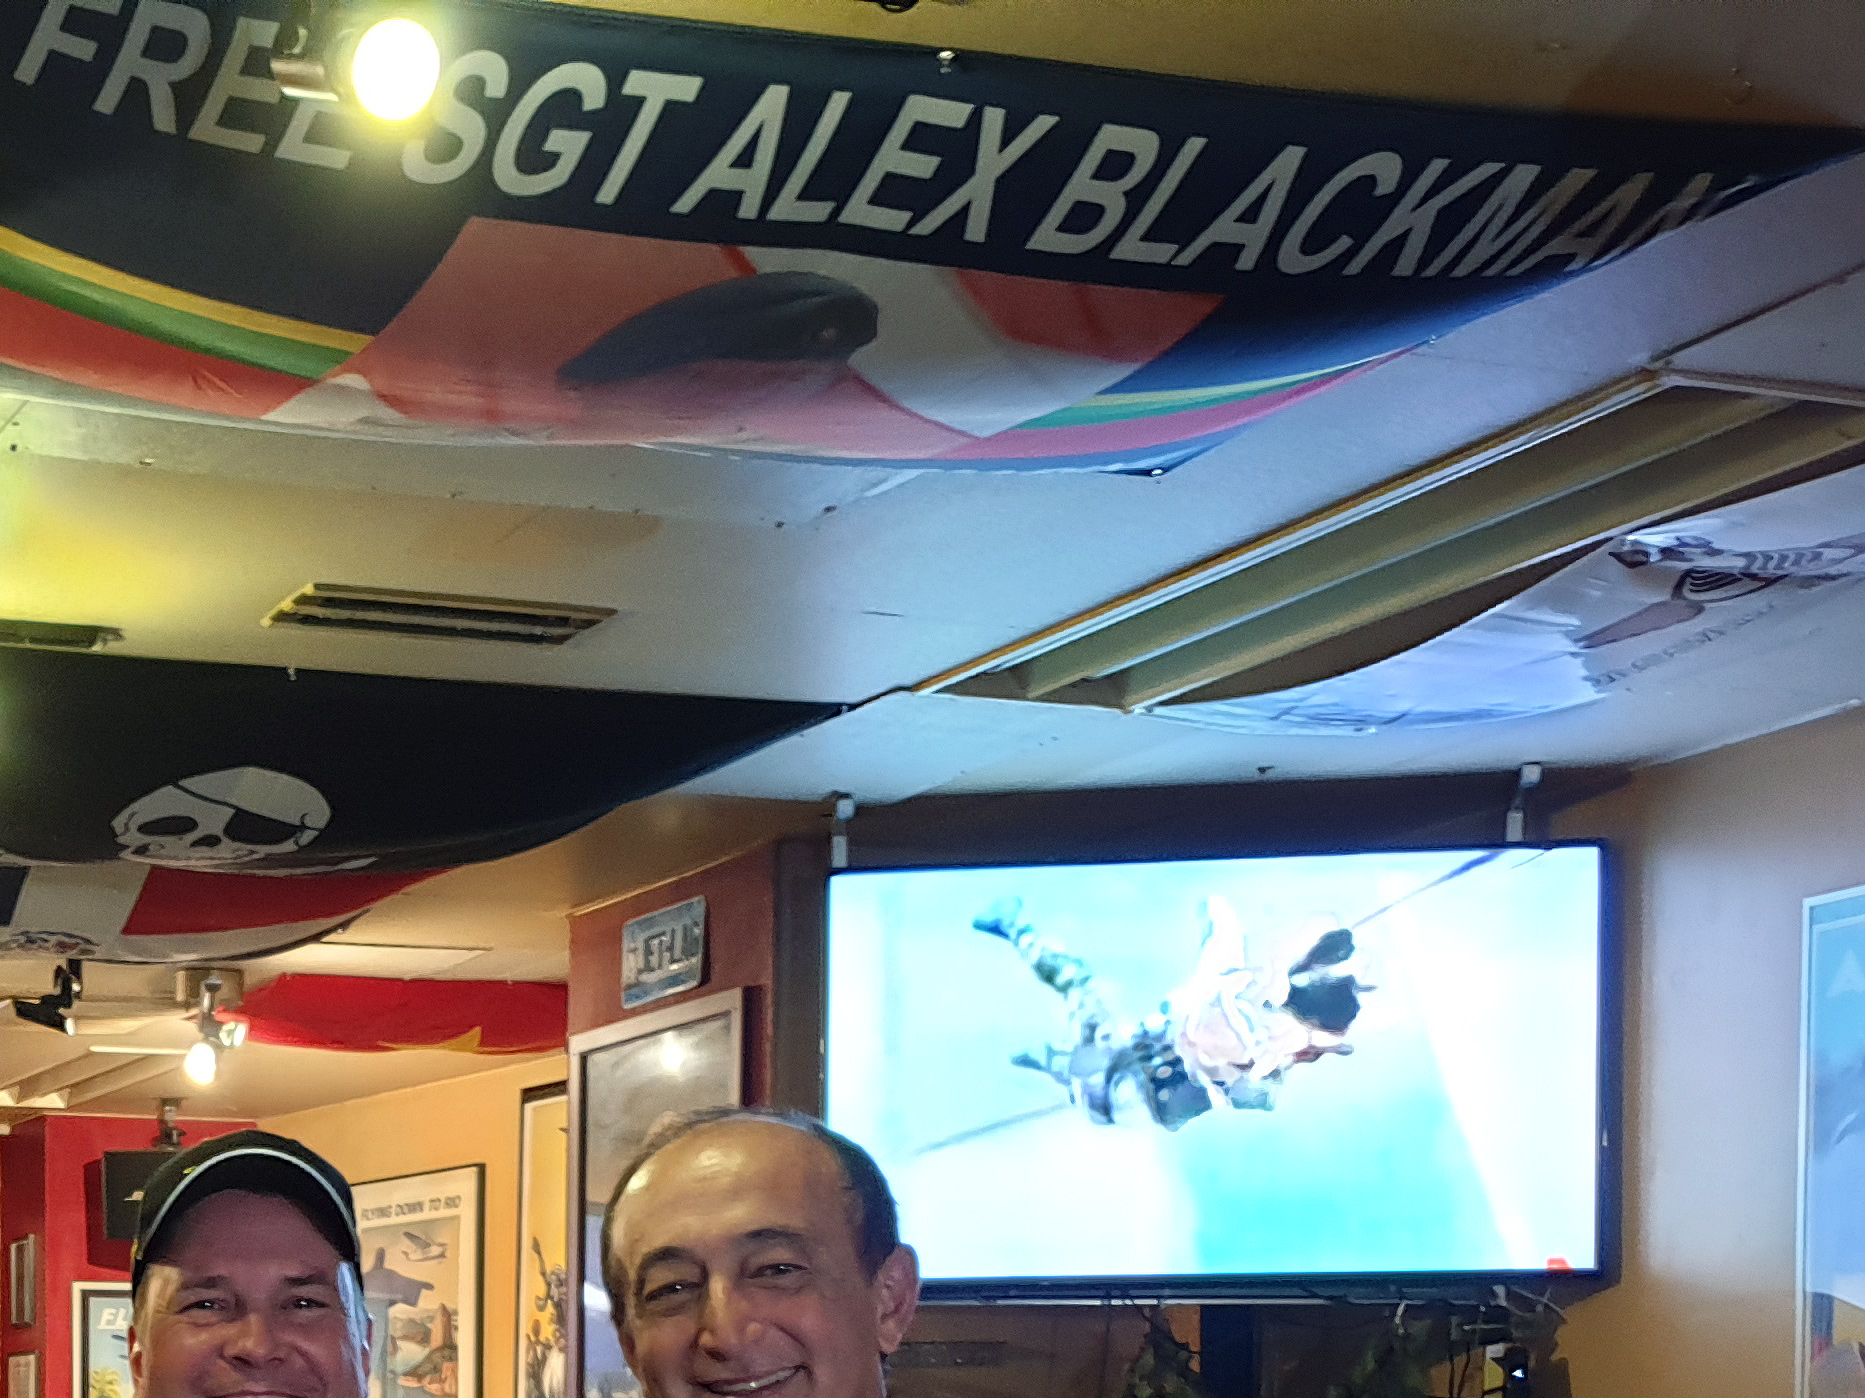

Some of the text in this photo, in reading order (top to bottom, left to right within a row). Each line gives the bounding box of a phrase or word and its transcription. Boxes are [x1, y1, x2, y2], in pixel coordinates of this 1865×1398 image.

[401, 49, 705, 206] SGT
[669, 84, 1060, 243] ALEX
[428, 1197, 442, 1212] TO
